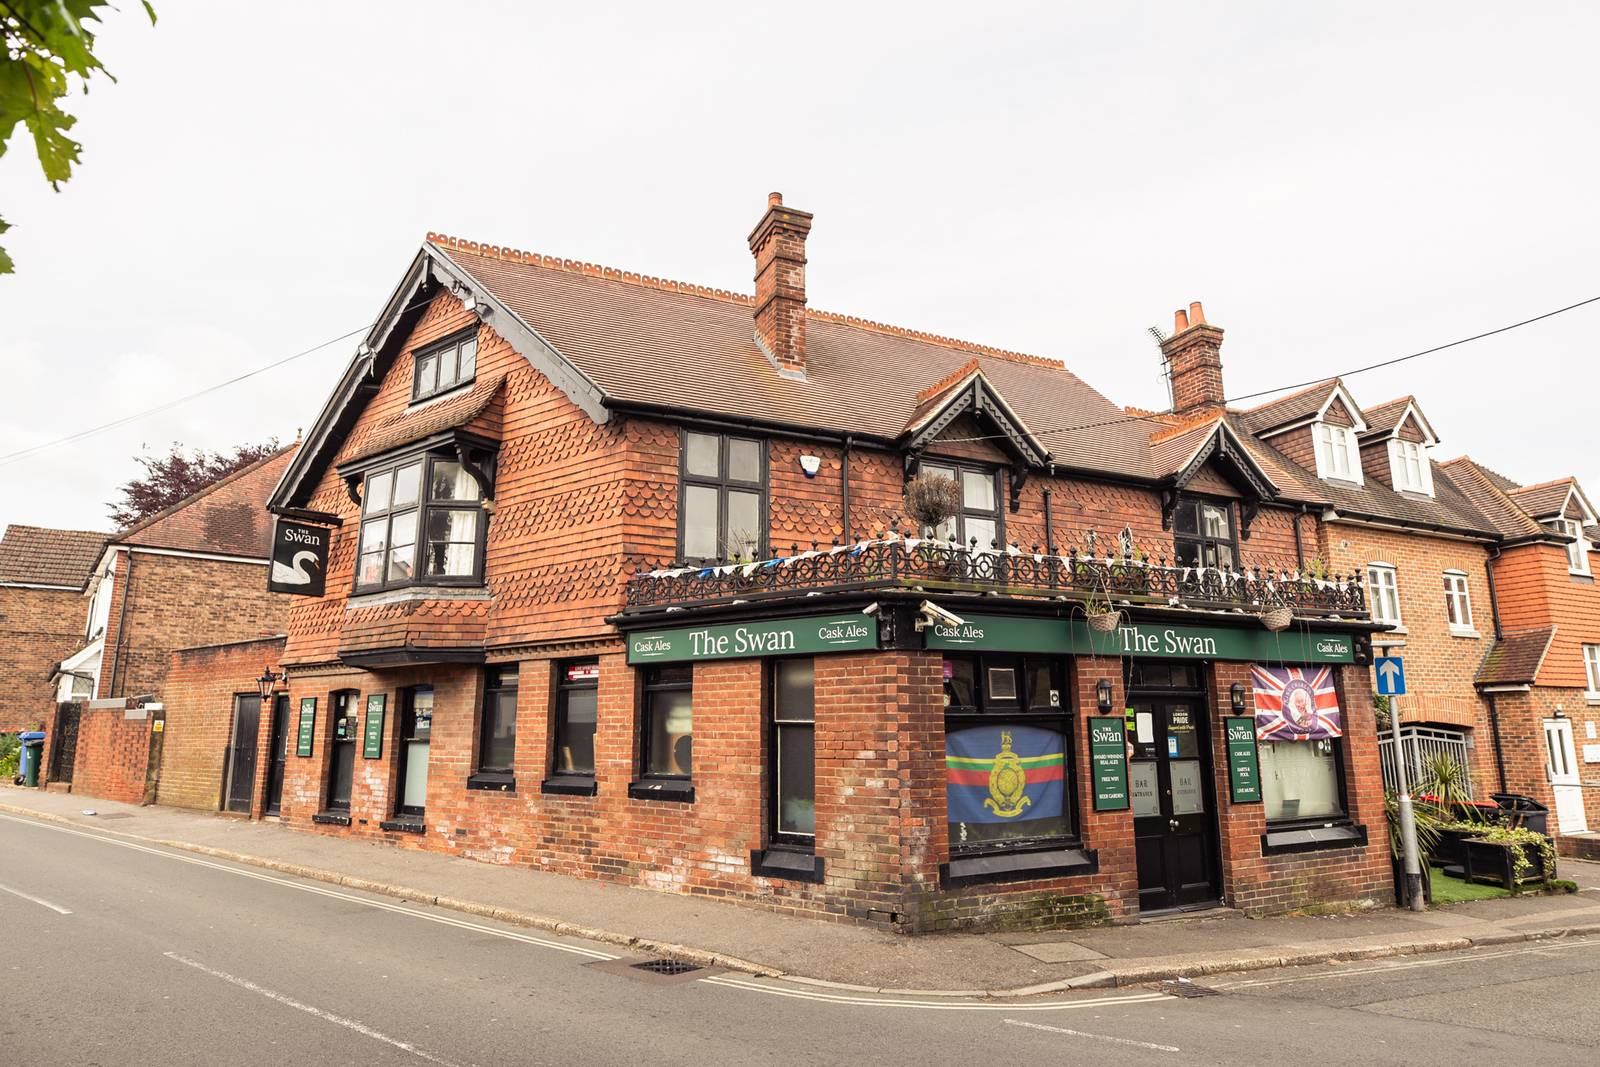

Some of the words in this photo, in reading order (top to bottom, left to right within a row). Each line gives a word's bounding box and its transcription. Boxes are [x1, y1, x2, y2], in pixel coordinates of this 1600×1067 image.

[284, 528, 320, 545] Swan
[818, 626, 844, 640] Cask
[845, 625, 868, 637] Ales
[934, 624, 960, 638] Cask
[962, 626, 984, 639] Ales
[634, 641, 652, 652] Cask
[654, 640, 671, 651] Ales
[689, 631, 728, 656] The
[734, 628, 795, 654] Swan
[1118, 627, 1160, 652] The
[1165, 630, 1217, 655] Swan
[1316, 642, 1333, 653] Cask
[1334, 644, 1348, 654] Ales
[368, 703, 383, 712] Swan
[1093, 729, 1122, 742] Swan
[1228, 728, 1253, 740] Swan
[1135, 780, 1148, 788] BAR
